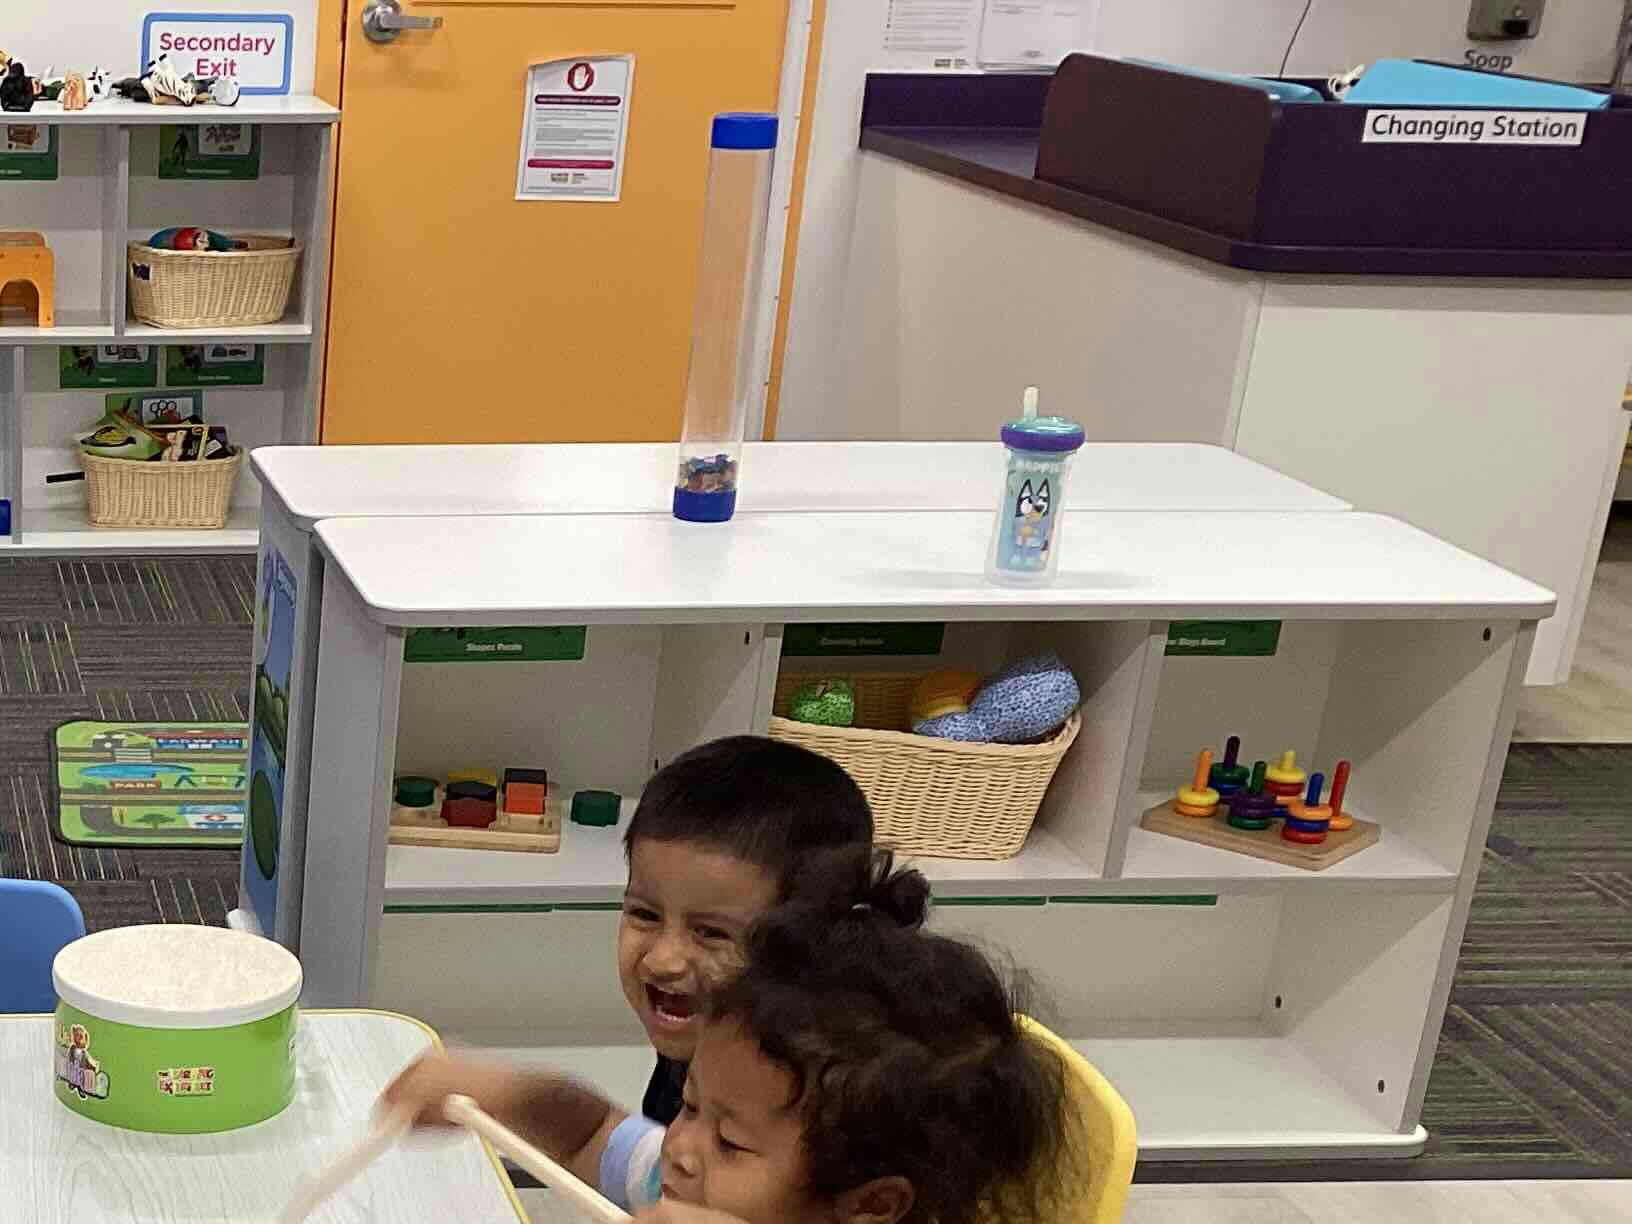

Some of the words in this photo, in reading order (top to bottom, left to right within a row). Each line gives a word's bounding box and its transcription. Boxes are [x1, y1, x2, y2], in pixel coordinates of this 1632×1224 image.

[160, 33, 275, 55] Secondary
[196, 58, 237, 76] Exit
[1465, 49, 1512, 71] Soap
[1372, 114, 1484, 141] Changing
[1493, 115, 1578, 138] Station
